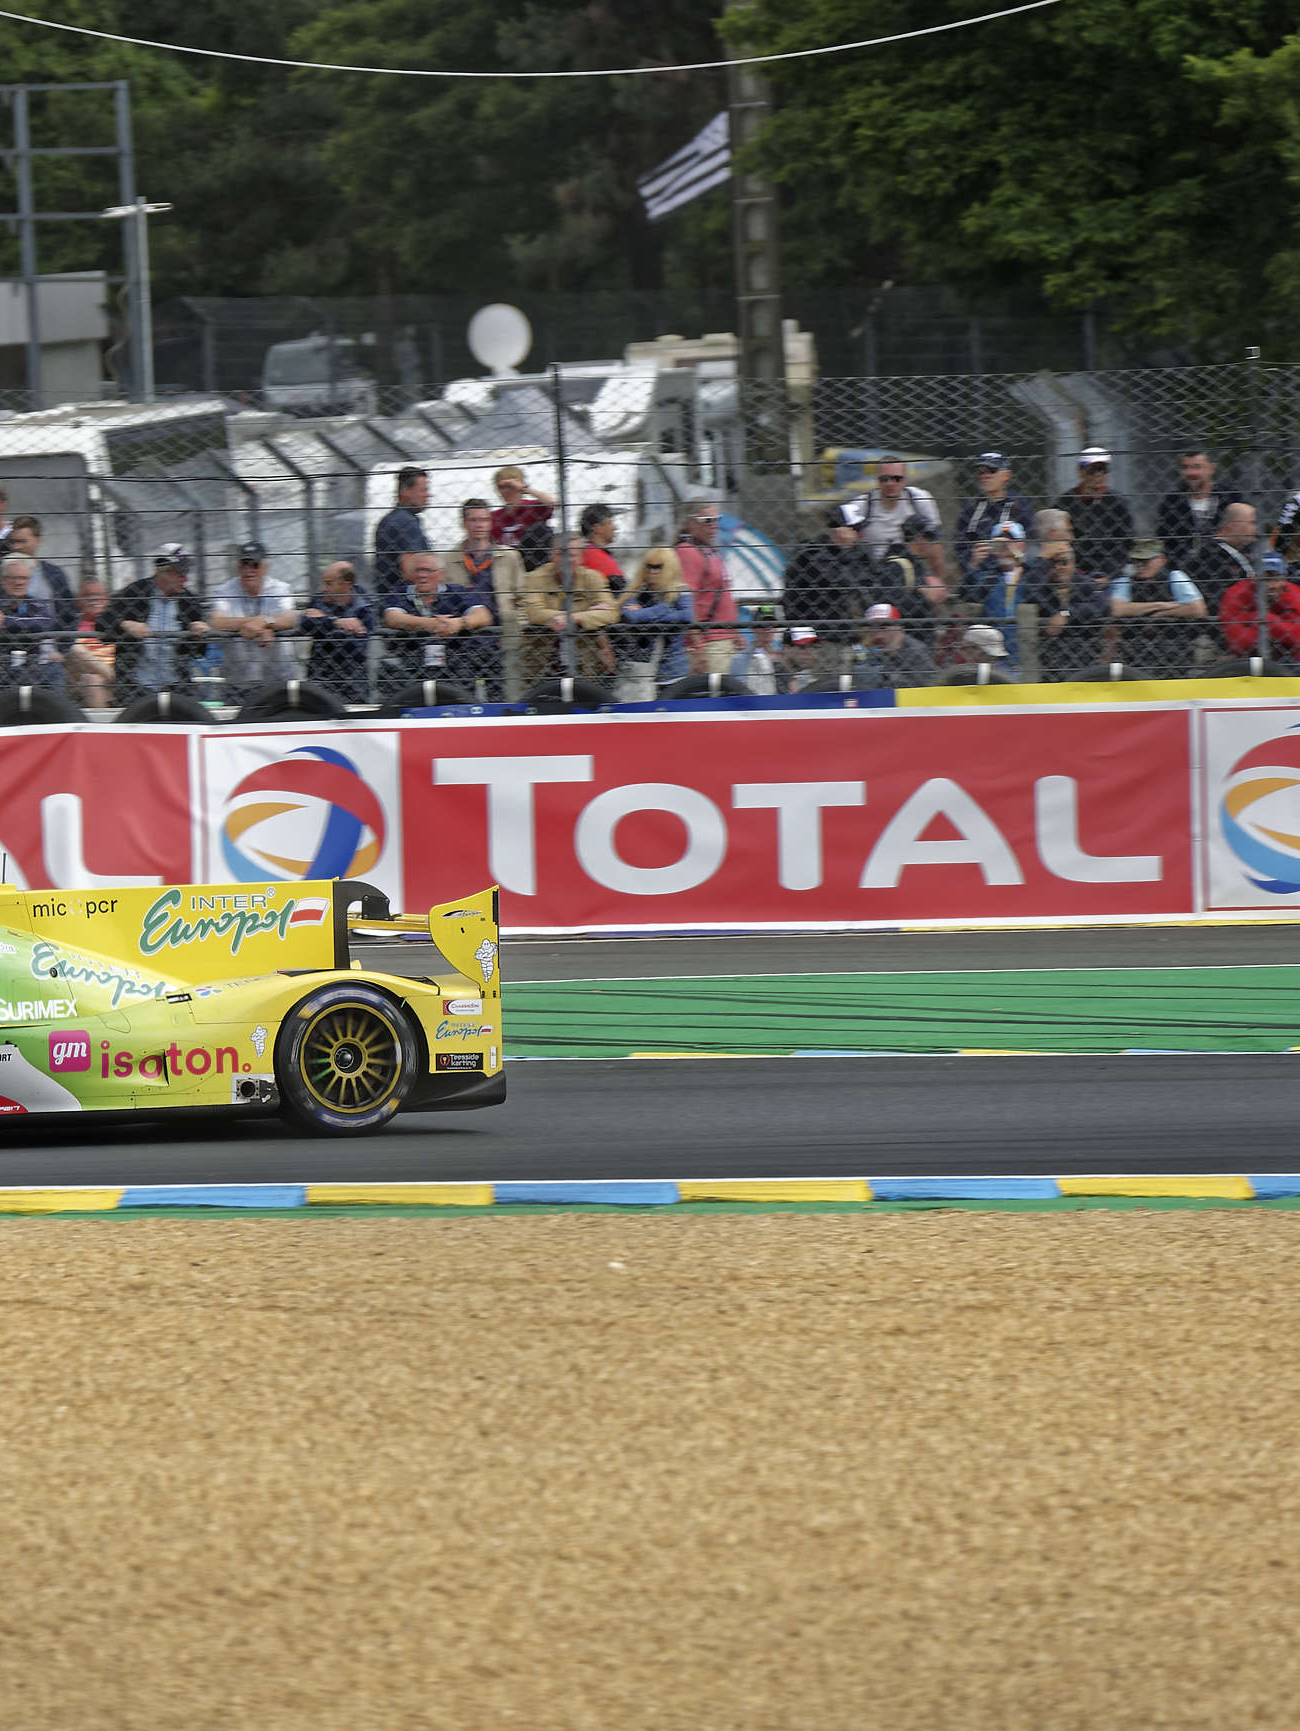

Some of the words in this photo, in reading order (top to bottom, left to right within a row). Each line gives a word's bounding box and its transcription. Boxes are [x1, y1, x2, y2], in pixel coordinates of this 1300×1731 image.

[433, 755, 1162, 897] TOTAL
[140, 889, 295, 955] Europol
[31, 942, 167, 1009] Europol
[52, 1040, 87, 1065] gm
[436, 1020, 483, 1040] Europol
